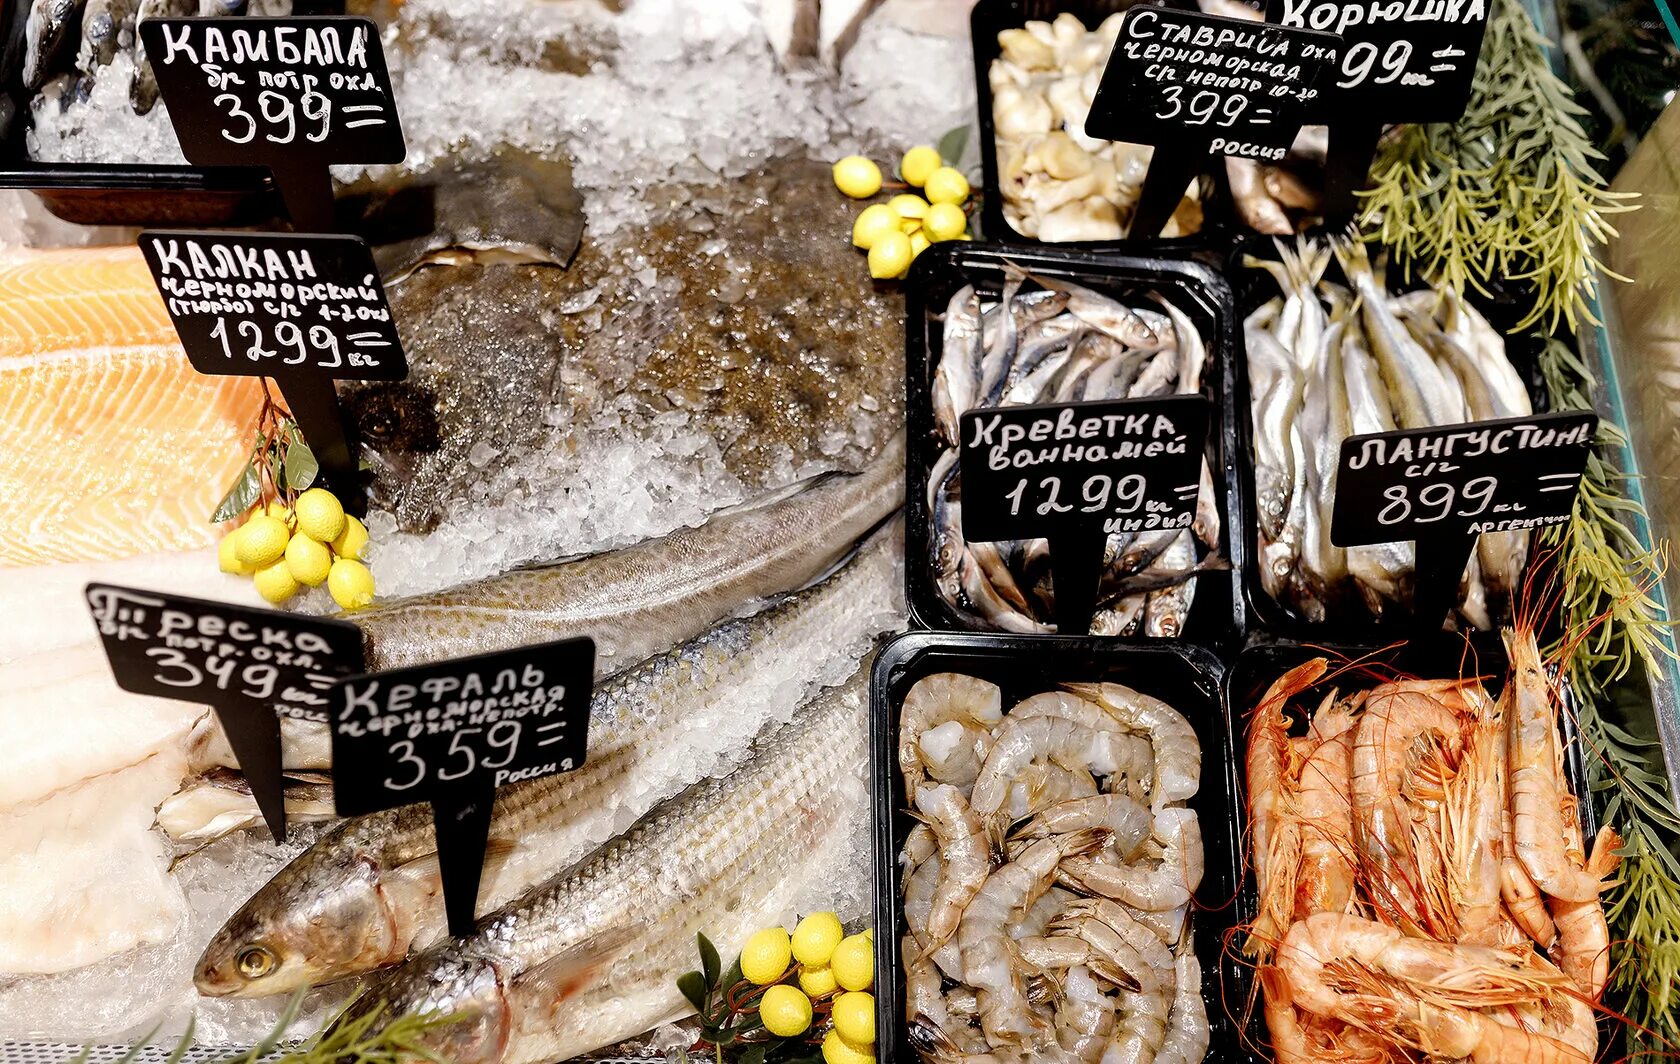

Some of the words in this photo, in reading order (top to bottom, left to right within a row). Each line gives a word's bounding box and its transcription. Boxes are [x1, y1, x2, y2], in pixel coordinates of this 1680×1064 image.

[162, 24, 368, 68] КАМБАЛА
[1124, 41, 1301, 82] черноморская
[152, 238, 317, 281] КАЛКАН
[161, 274, 379, 305] черноморский
